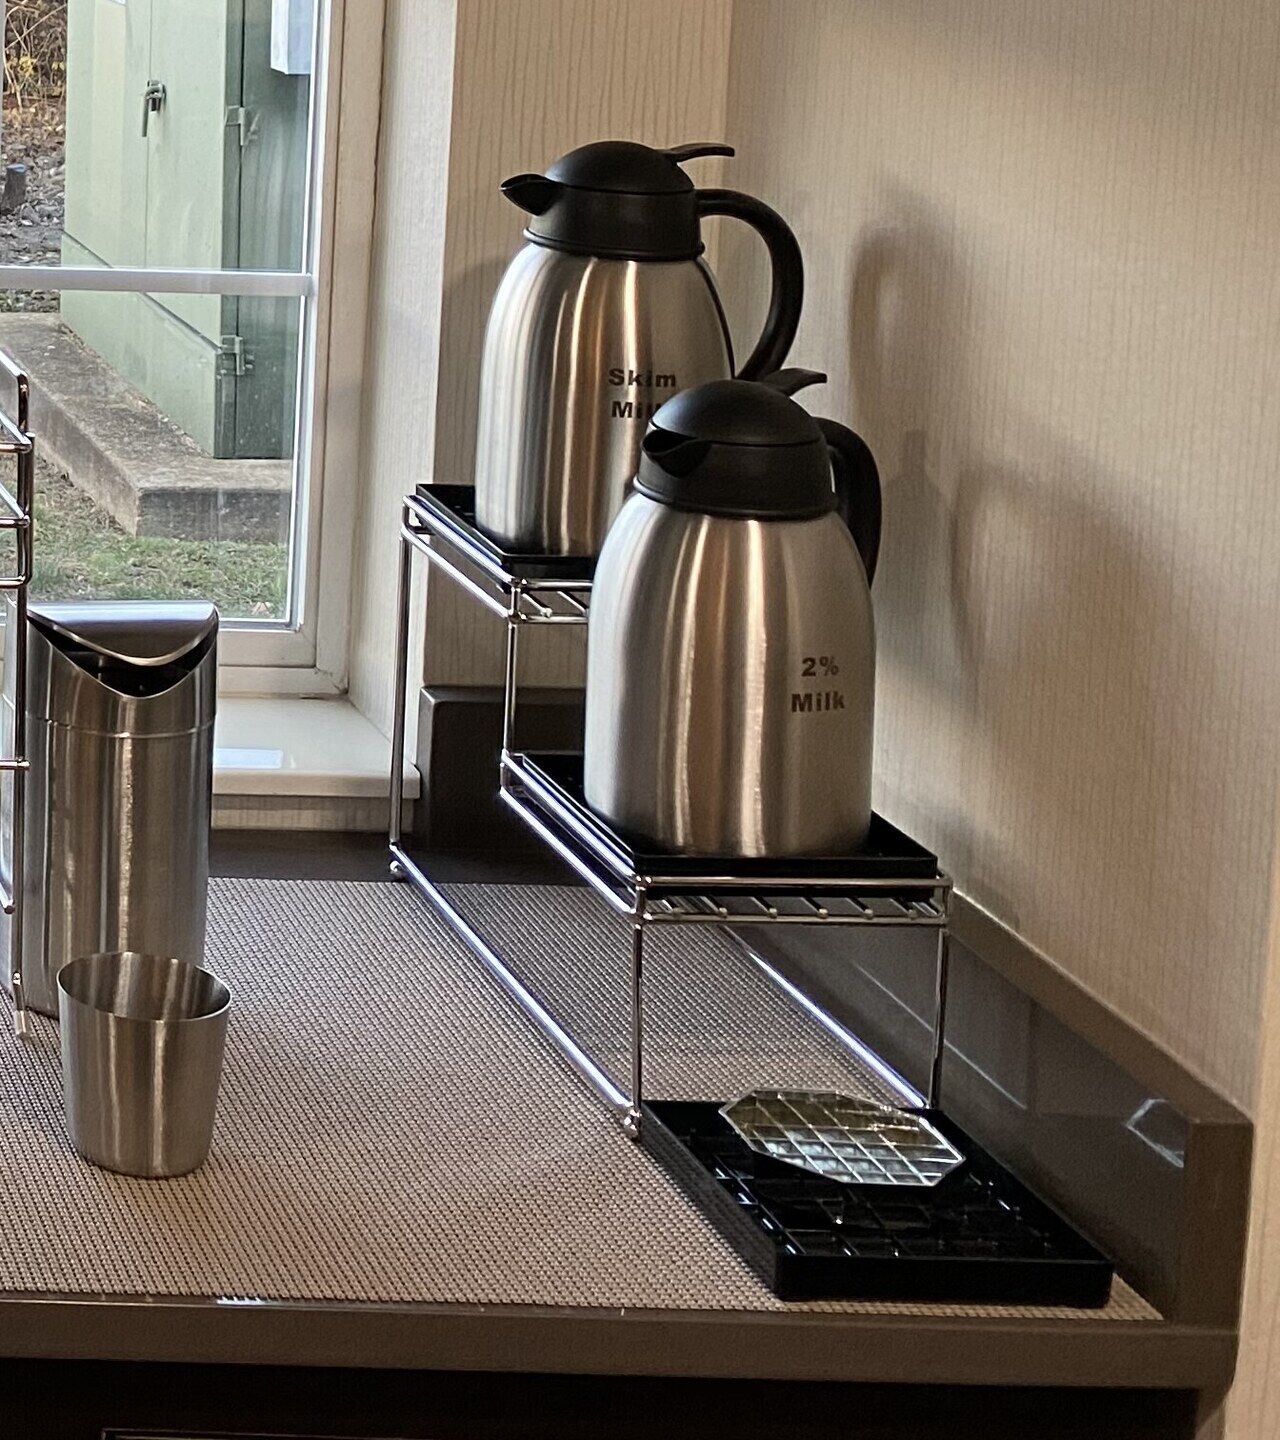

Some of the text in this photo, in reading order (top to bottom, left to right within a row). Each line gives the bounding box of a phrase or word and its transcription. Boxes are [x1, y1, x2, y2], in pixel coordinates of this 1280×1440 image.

[608, 367, 676, 388] Skim
[611, 400, 663, 420] Mil
[801, 656, 840, 677] 2%
[791, 690, 845, 713] Milk
